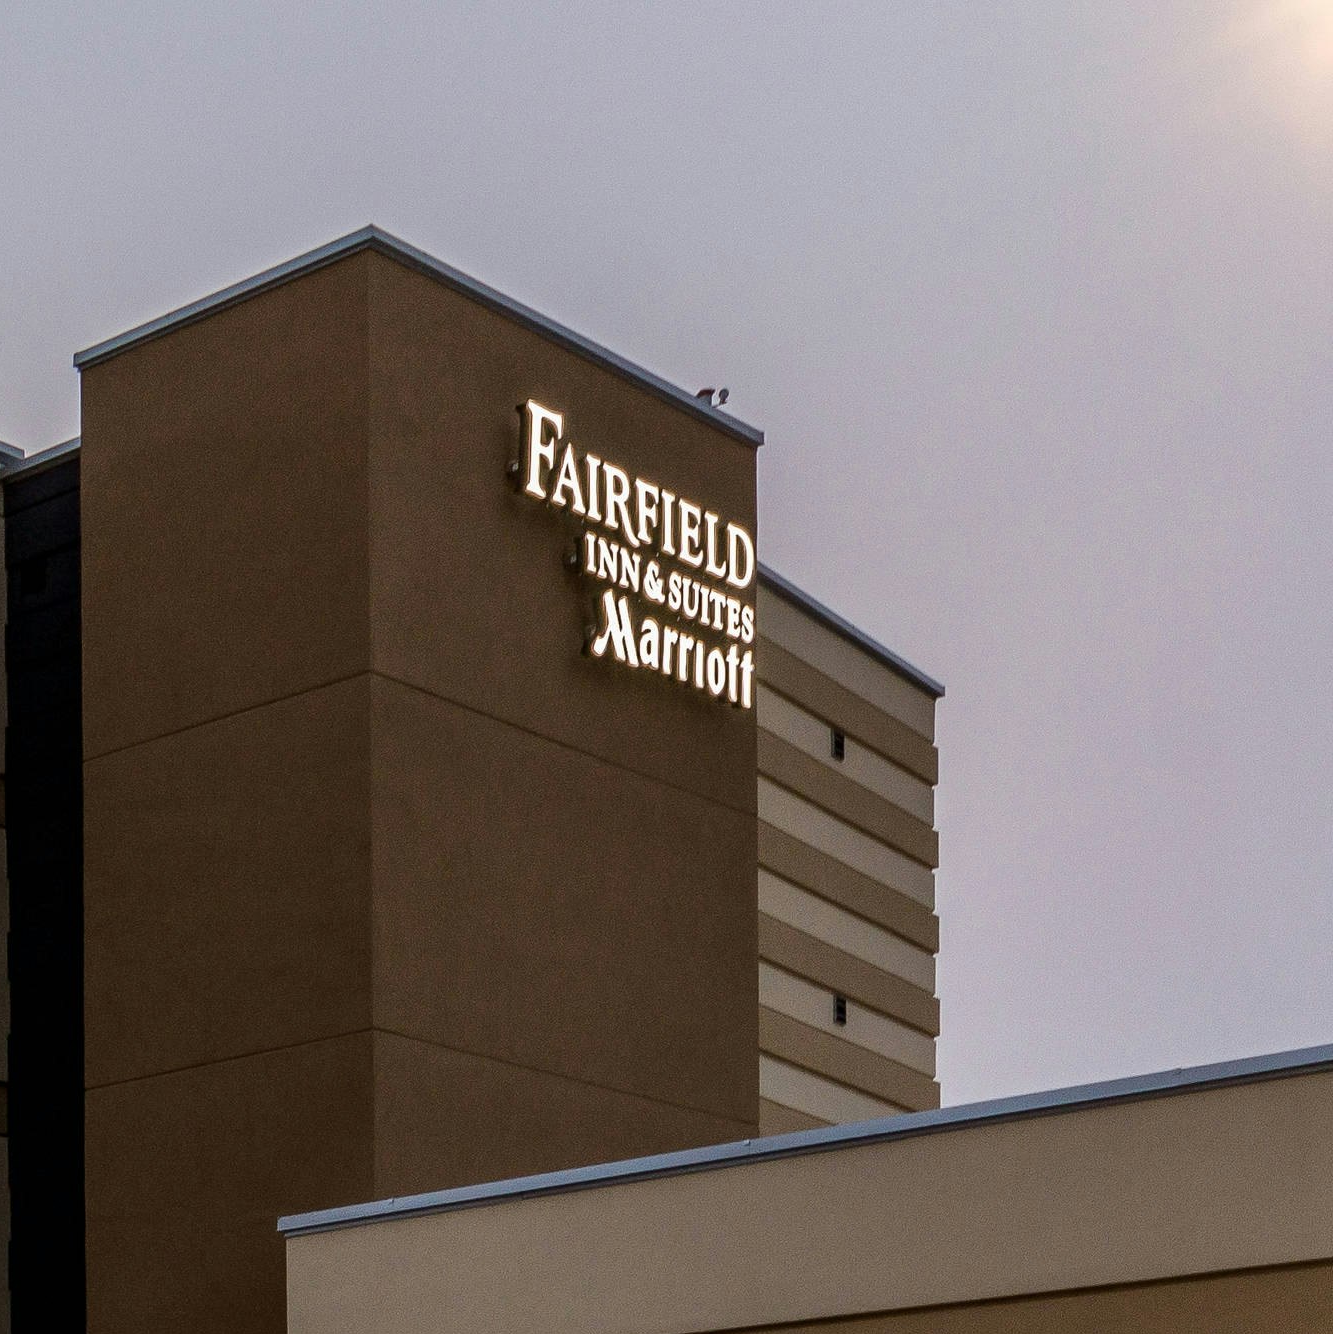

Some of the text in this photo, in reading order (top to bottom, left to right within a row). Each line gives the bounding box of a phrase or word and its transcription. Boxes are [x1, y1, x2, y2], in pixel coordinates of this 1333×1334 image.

[525, 399, 755, 589] FAIRFIELD
[585, 531, 755, 643] INN & SUITES
[592, 589, 755, 709] Marriott
